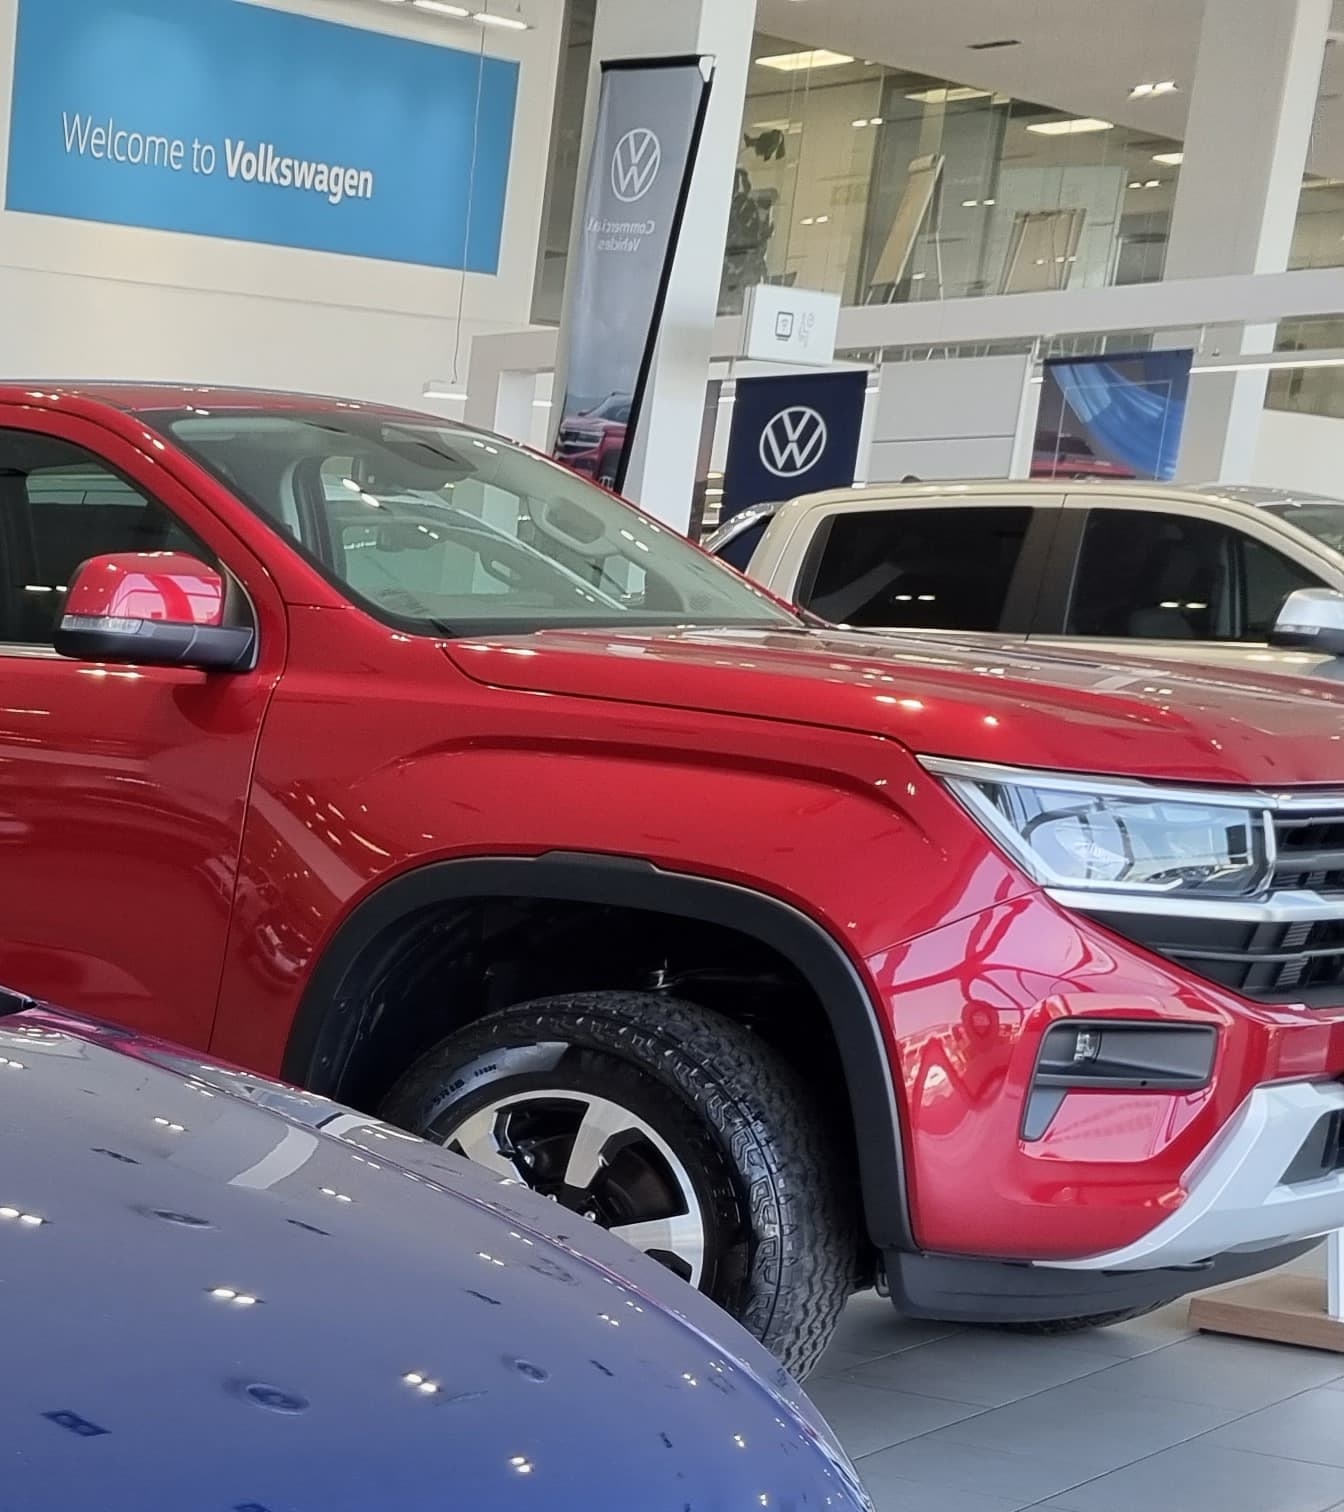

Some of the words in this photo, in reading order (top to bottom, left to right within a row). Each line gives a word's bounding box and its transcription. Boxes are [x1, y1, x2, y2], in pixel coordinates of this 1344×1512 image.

[62, 111, 184, 171] Welcome
[191, 137, 216, 175] to
[223, 138, 374, 205] Volkswagen
